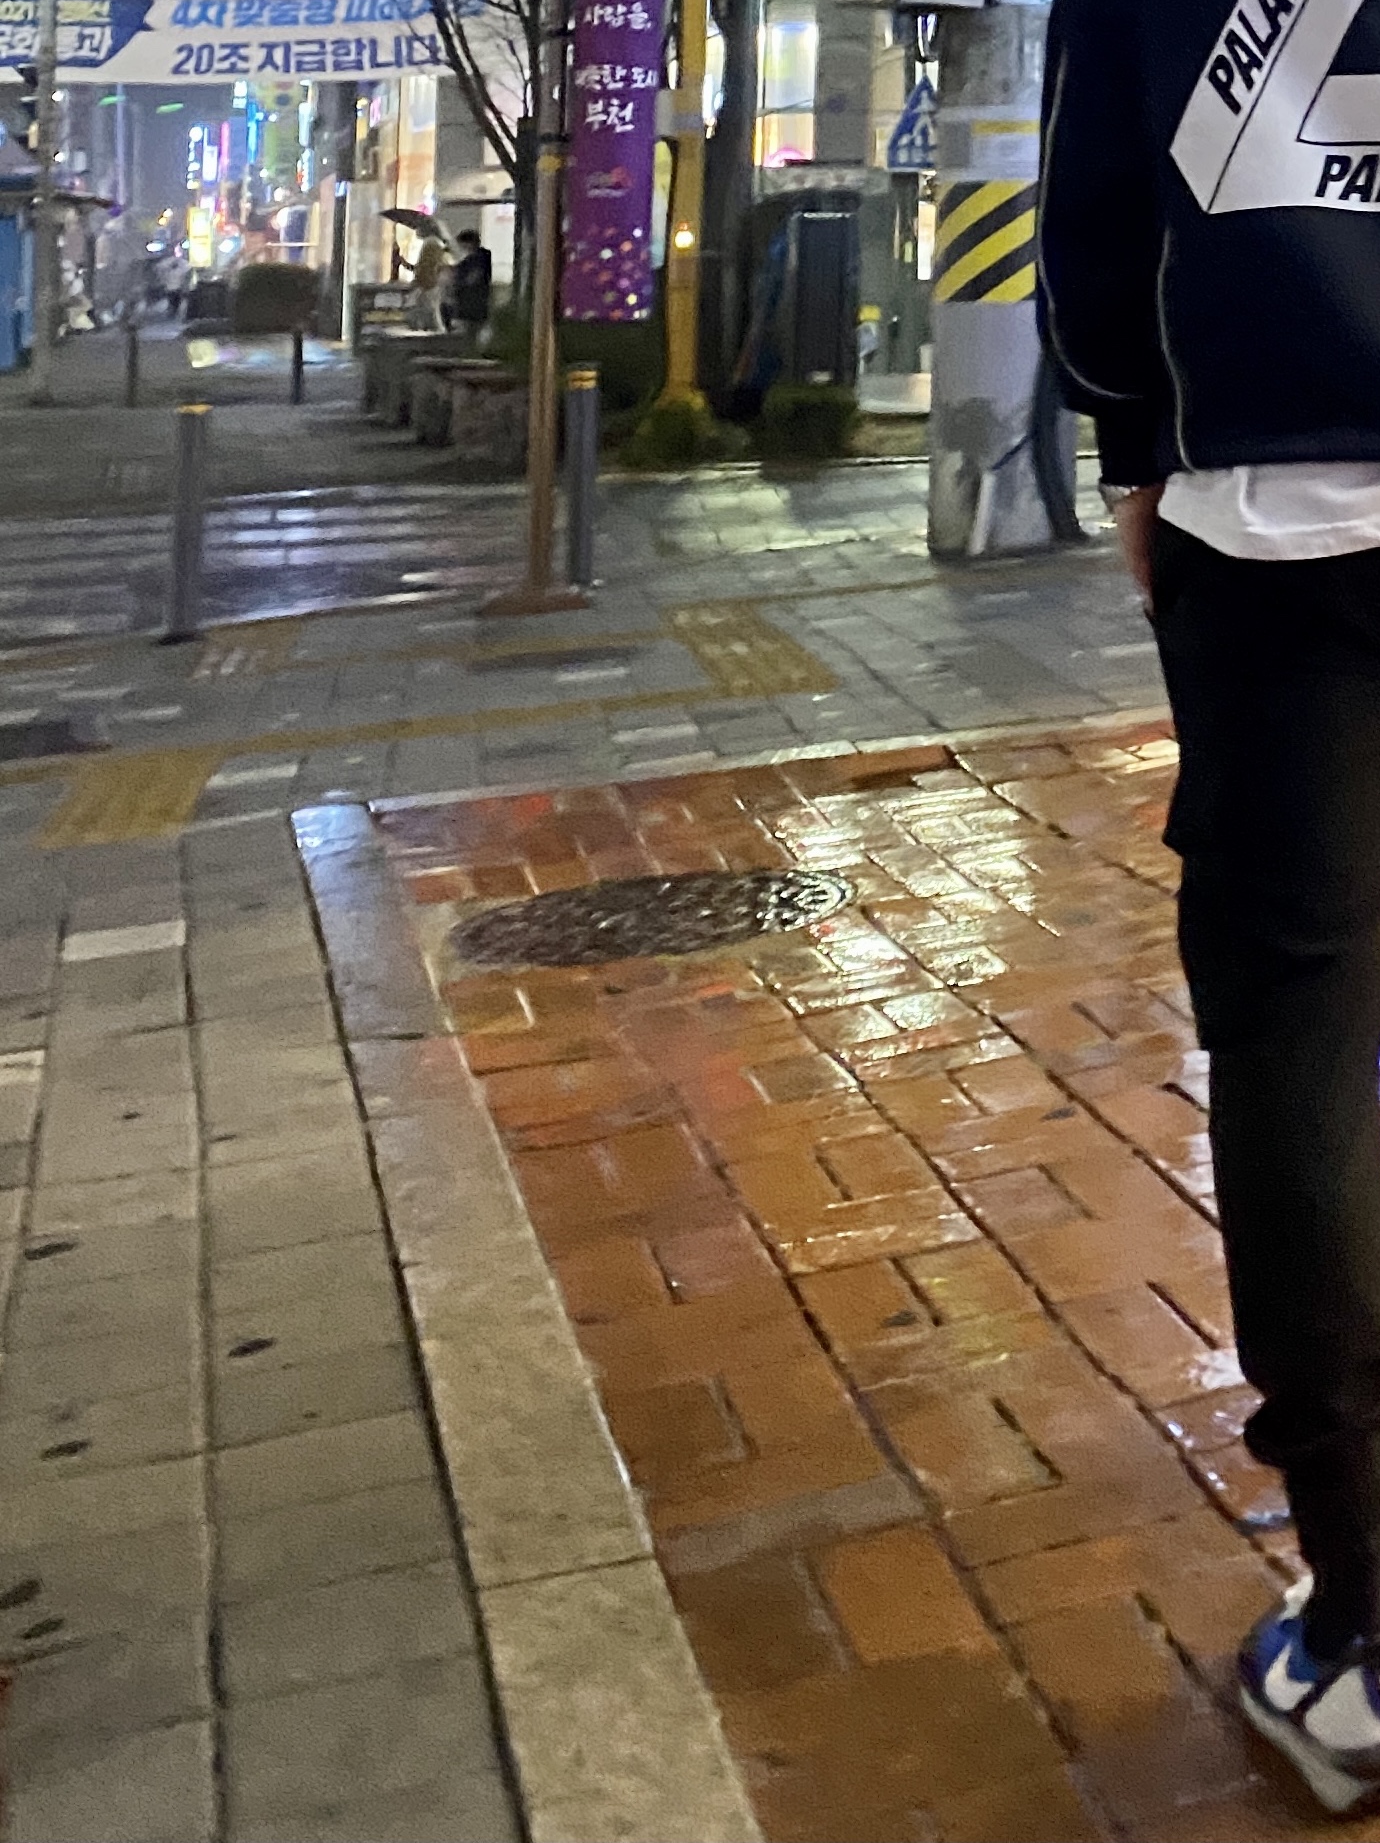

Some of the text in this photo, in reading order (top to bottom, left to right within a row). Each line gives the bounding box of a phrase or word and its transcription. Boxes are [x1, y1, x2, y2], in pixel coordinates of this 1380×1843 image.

[170, 33, 446, 76] 20조 지급합니다
[584, 98, 635, 134] 부천
